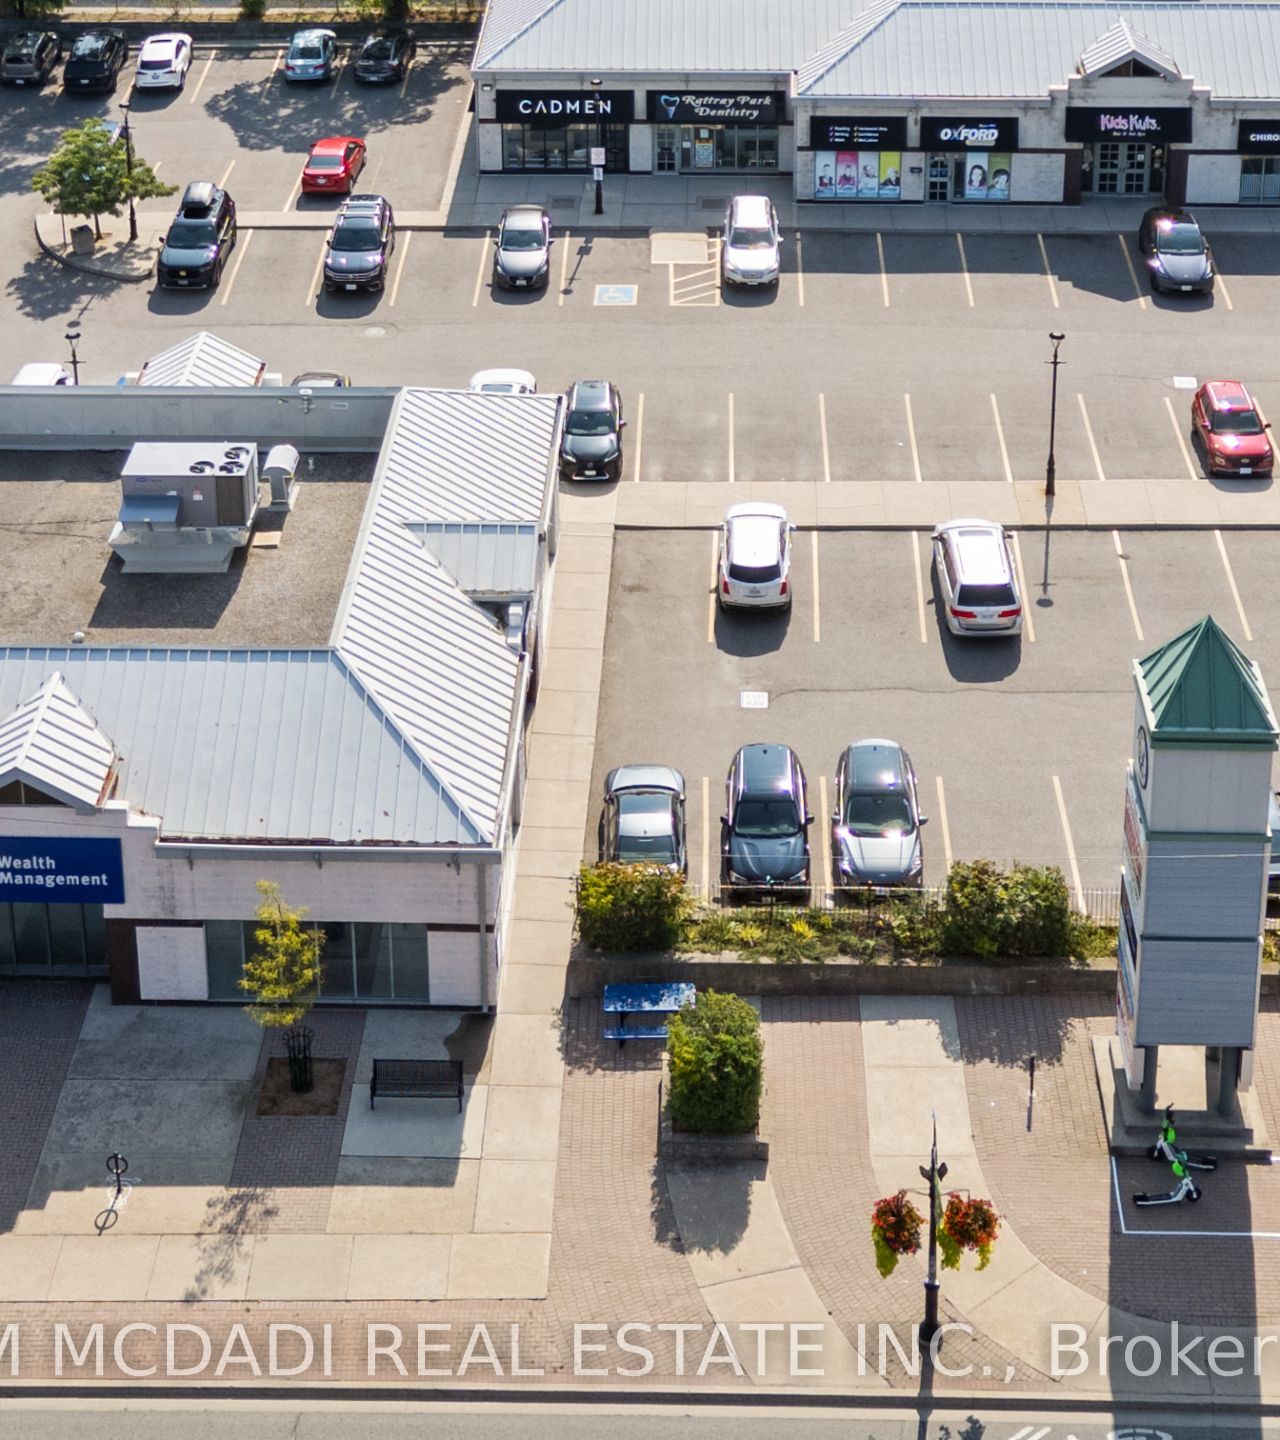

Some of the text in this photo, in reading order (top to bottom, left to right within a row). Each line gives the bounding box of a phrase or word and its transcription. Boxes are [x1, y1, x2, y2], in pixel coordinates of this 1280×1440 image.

[519, 99, 612, 114] CADMEN
[681, 95, 772, 107] Rattray Park
[694, 106, 759, 119] Dentistry
[1100, 114, 1128, 131] Kids
[940, 124, 999, 141] OXFORD
[0, 872, 108, 888] Management
